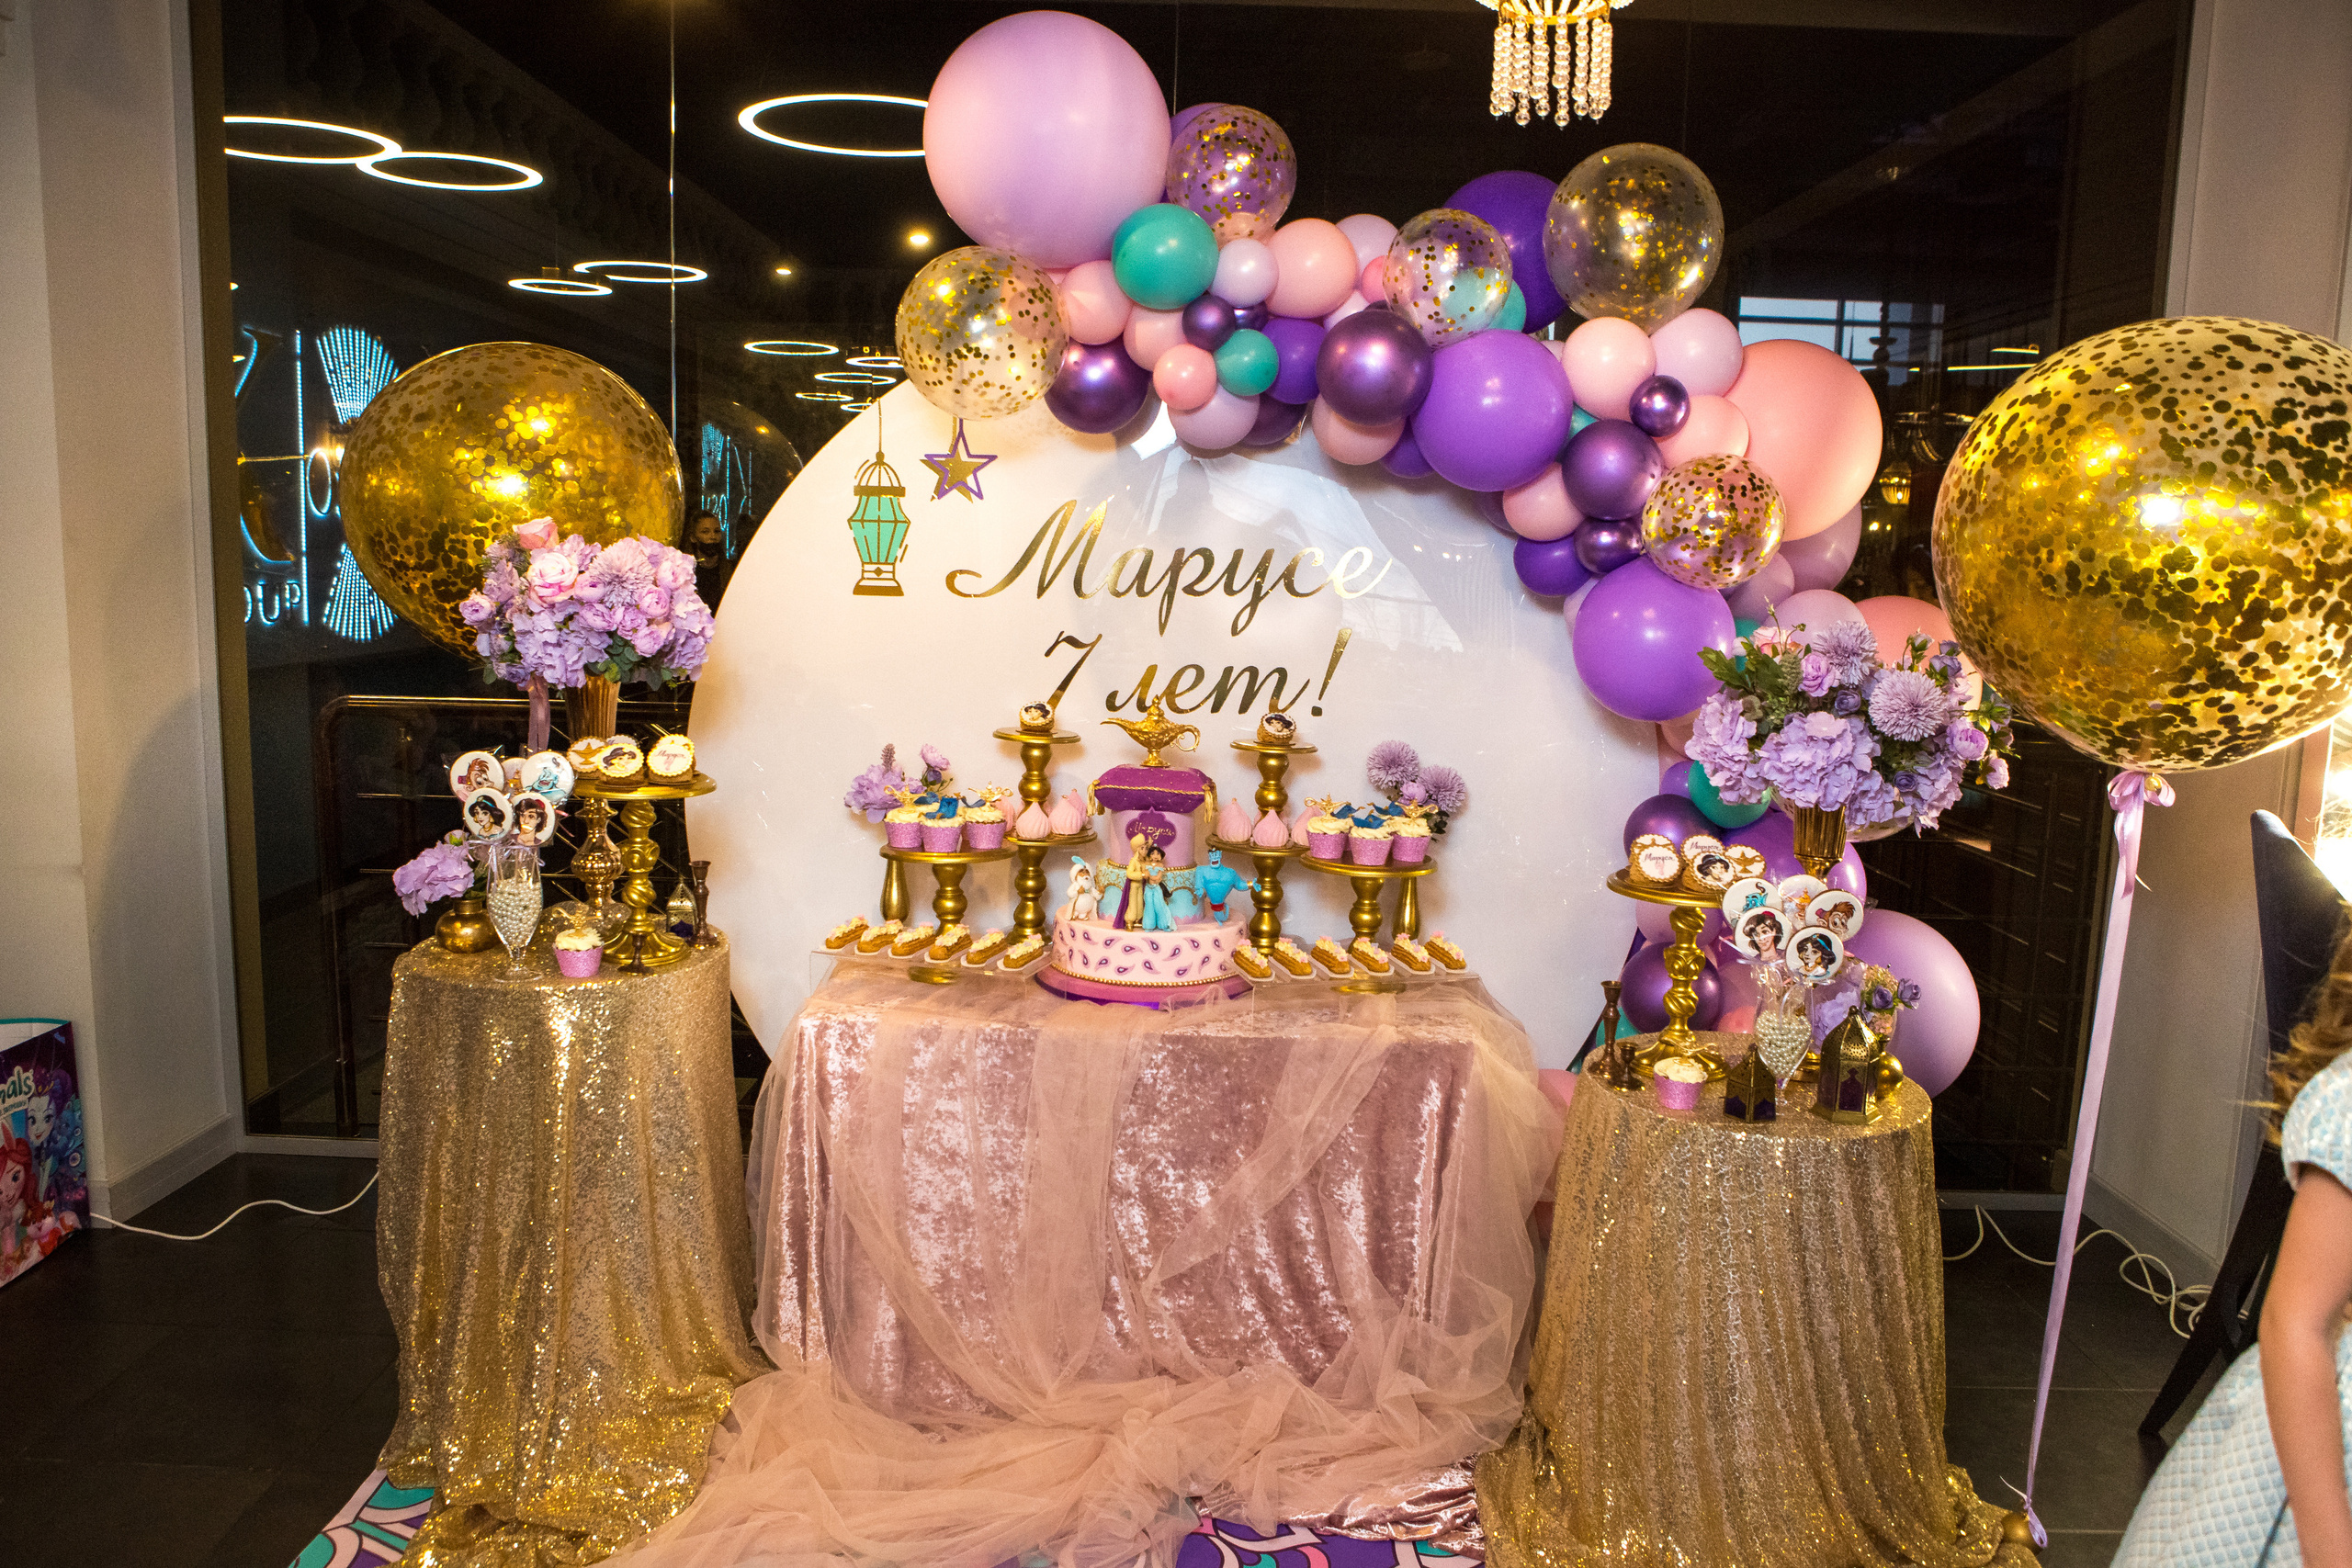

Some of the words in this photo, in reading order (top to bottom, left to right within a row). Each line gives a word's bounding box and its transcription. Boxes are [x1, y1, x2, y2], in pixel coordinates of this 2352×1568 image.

[945, 498, 1393, 637] Марусе
[1044, 630, 1102, 709] 7
[1105, 627, 1352, 717] лет!
